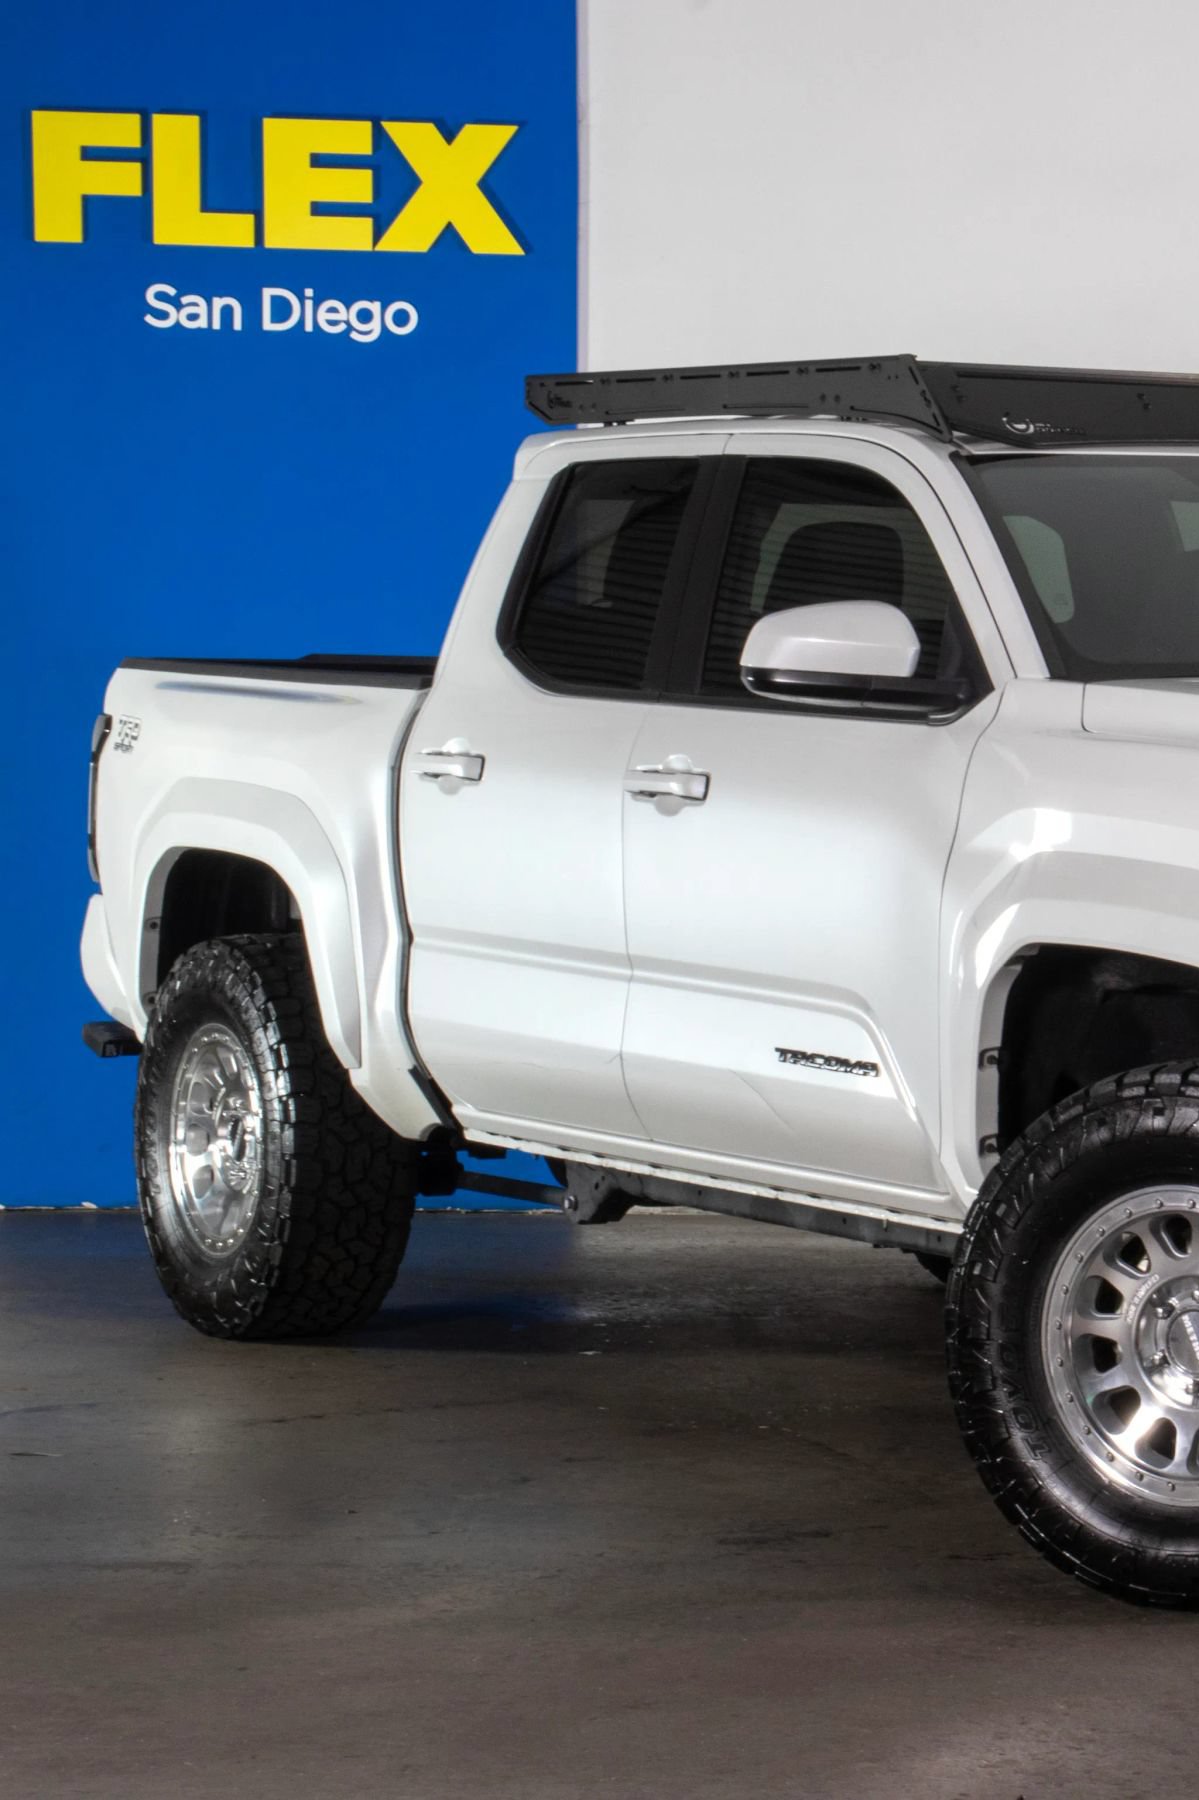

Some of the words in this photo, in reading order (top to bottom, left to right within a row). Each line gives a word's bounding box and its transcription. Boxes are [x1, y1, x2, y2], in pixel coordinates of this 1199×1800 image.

[31, 109, 526, 256] FLEX
[143, 283, 243, 332] San
[261, 287, 418, 343] Diego
[775, 1047, 880, 1077] TACOMA
